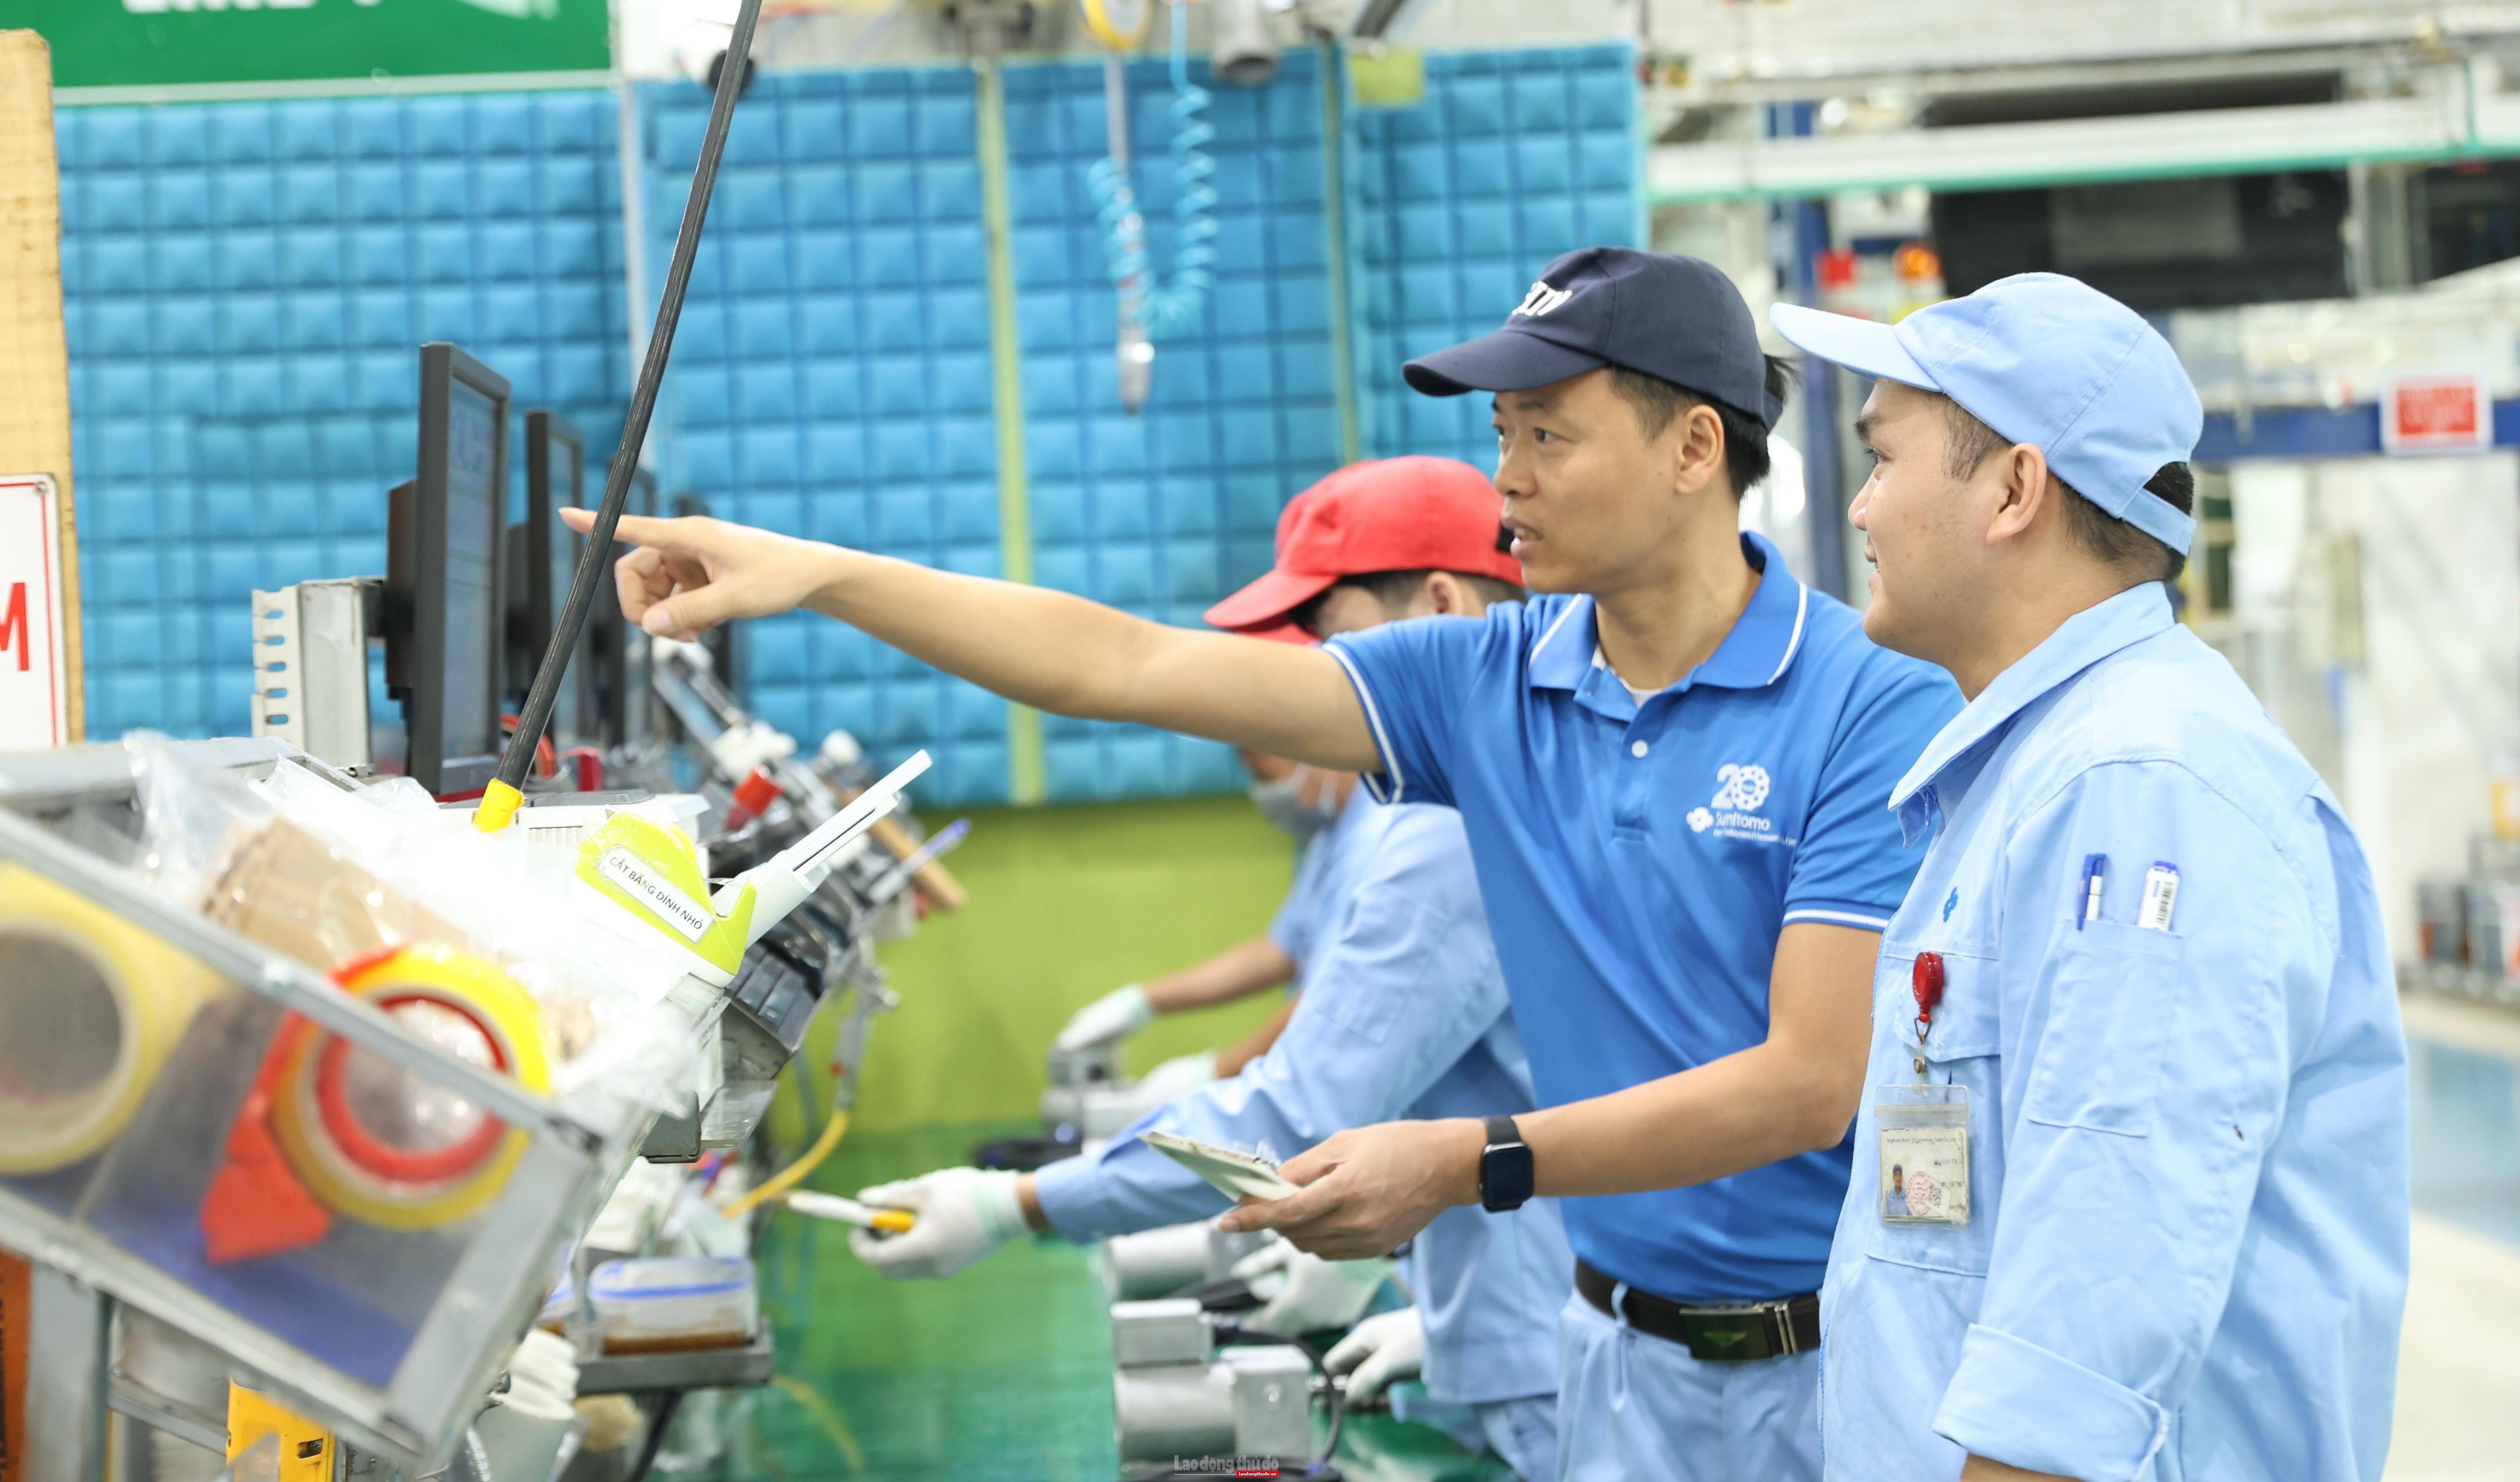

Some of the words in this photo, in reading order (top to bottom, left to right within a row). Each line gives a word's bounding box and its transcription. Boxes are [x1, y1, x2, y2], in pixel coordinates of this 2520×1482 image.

[610, 857, 630, 873] CẮT
[628, 871, 656, 894] BĂNG
[655, 892, 681, 913] DÍNH
[680, 910, 704, 929] NHỎ
